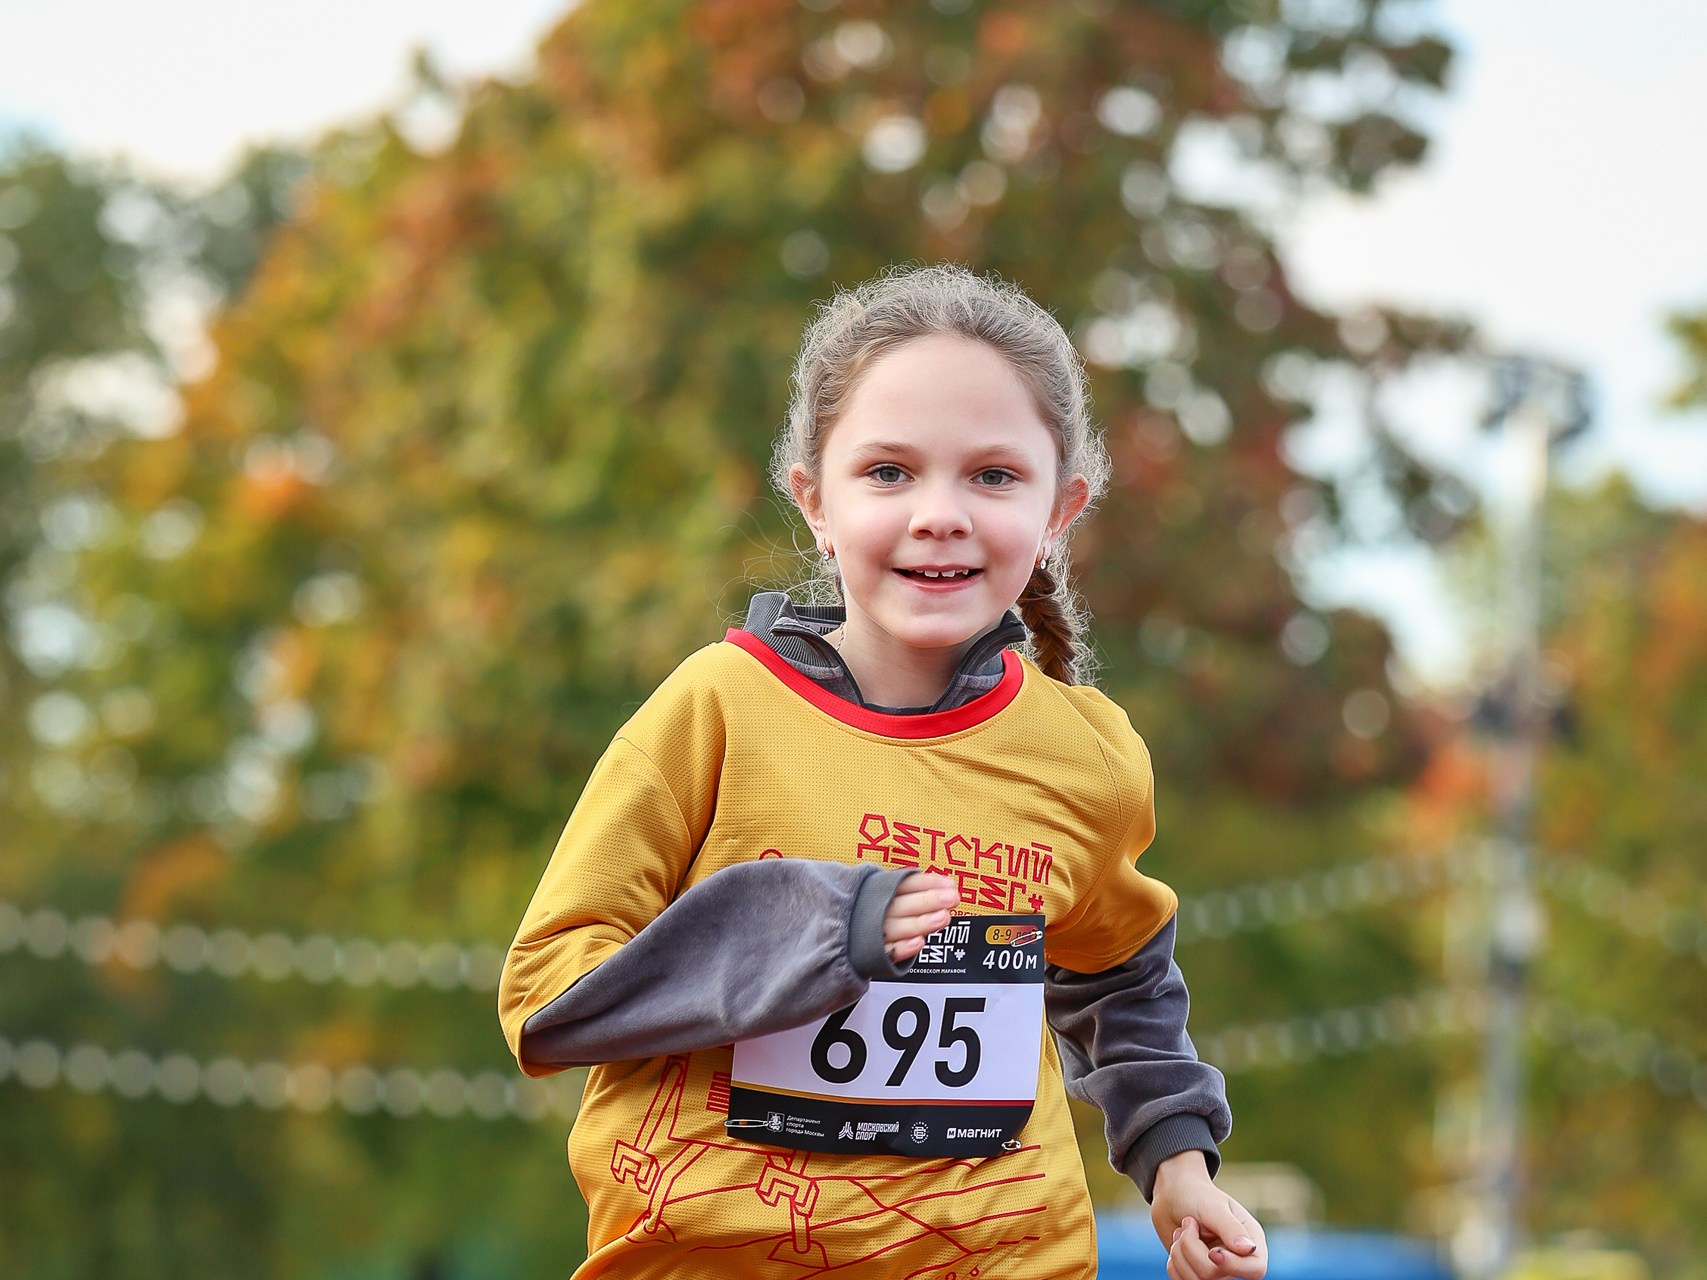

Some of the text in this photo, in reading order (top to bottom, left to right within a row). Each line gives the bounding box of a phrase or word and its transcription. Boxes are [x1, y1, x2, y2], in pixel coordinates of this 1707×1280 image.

[857, 813, 1053, 885] ДЕТСКИЙ
[993, 929, 1012, 941] 8-9
[919, 945, 954, 963] БЕГ
[811, 996, 987, 1087] 695
[857, 1121, 900, 1133] МОСКОВСКИЙ
[855, 1132, 877, 1141] СПОРТ
